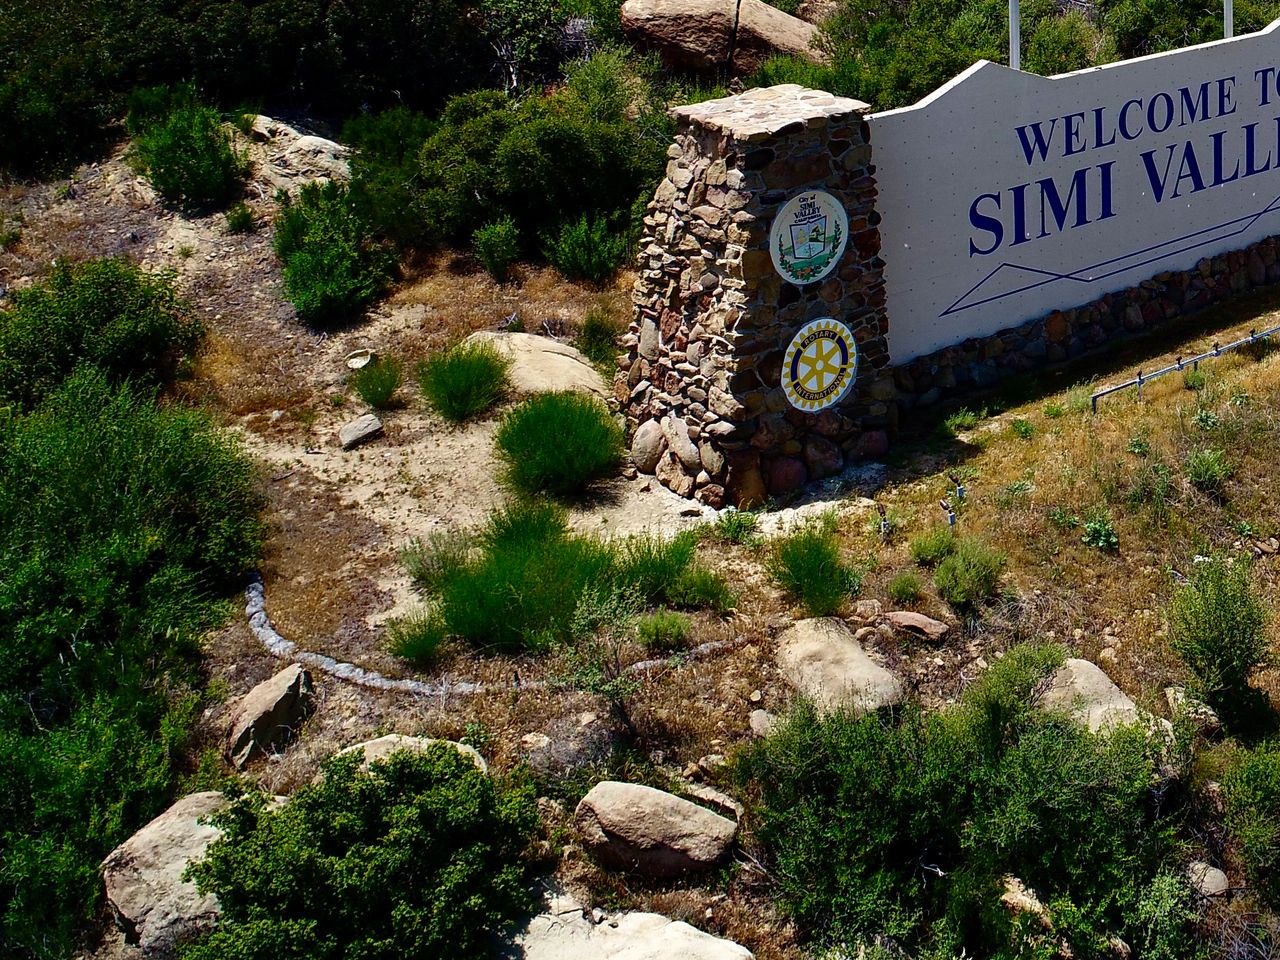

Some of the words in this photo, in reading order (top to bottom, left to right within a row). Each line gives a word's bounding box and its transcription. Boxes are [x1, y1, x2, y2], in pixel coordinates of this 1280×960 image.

[1015, 76, 1237, 166] WELCOME
[793, 206, 822, 219] VALLEY
[799, 201, 816, 210] SIMI
[968, 160, 1117, 258] SIMI
[804, 331, 835, 346] ROTARY
[795, 370, 845, 399] INTERNATIONAL
